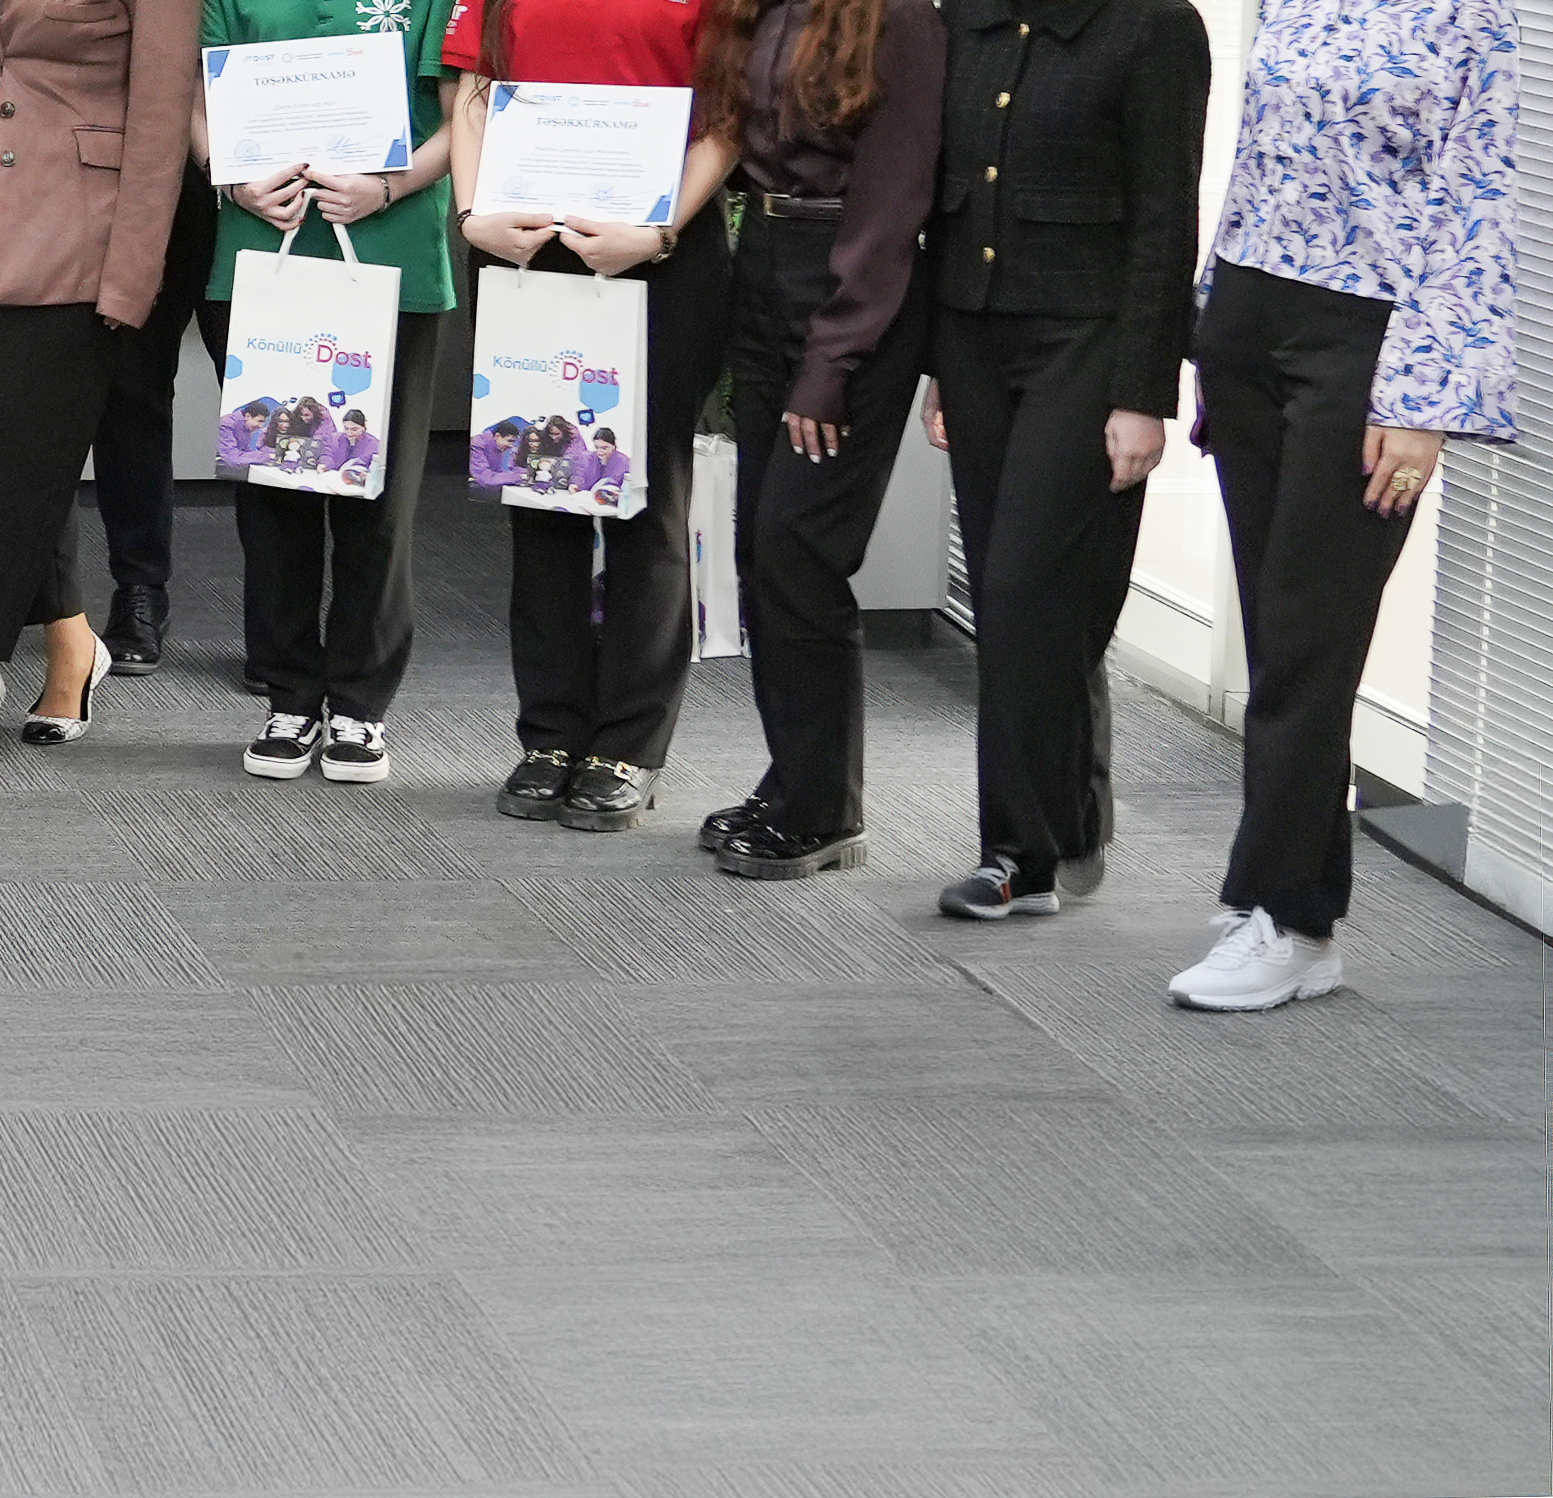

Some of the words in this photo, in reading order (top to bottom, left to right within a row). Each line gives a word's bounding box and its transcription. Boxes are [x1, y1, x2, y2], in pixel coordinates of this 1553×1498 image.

[247, 338, 302, 354] Könüllü
[316, 344, 372, 369] Dost
[562, 361, 619, 386] Dost
